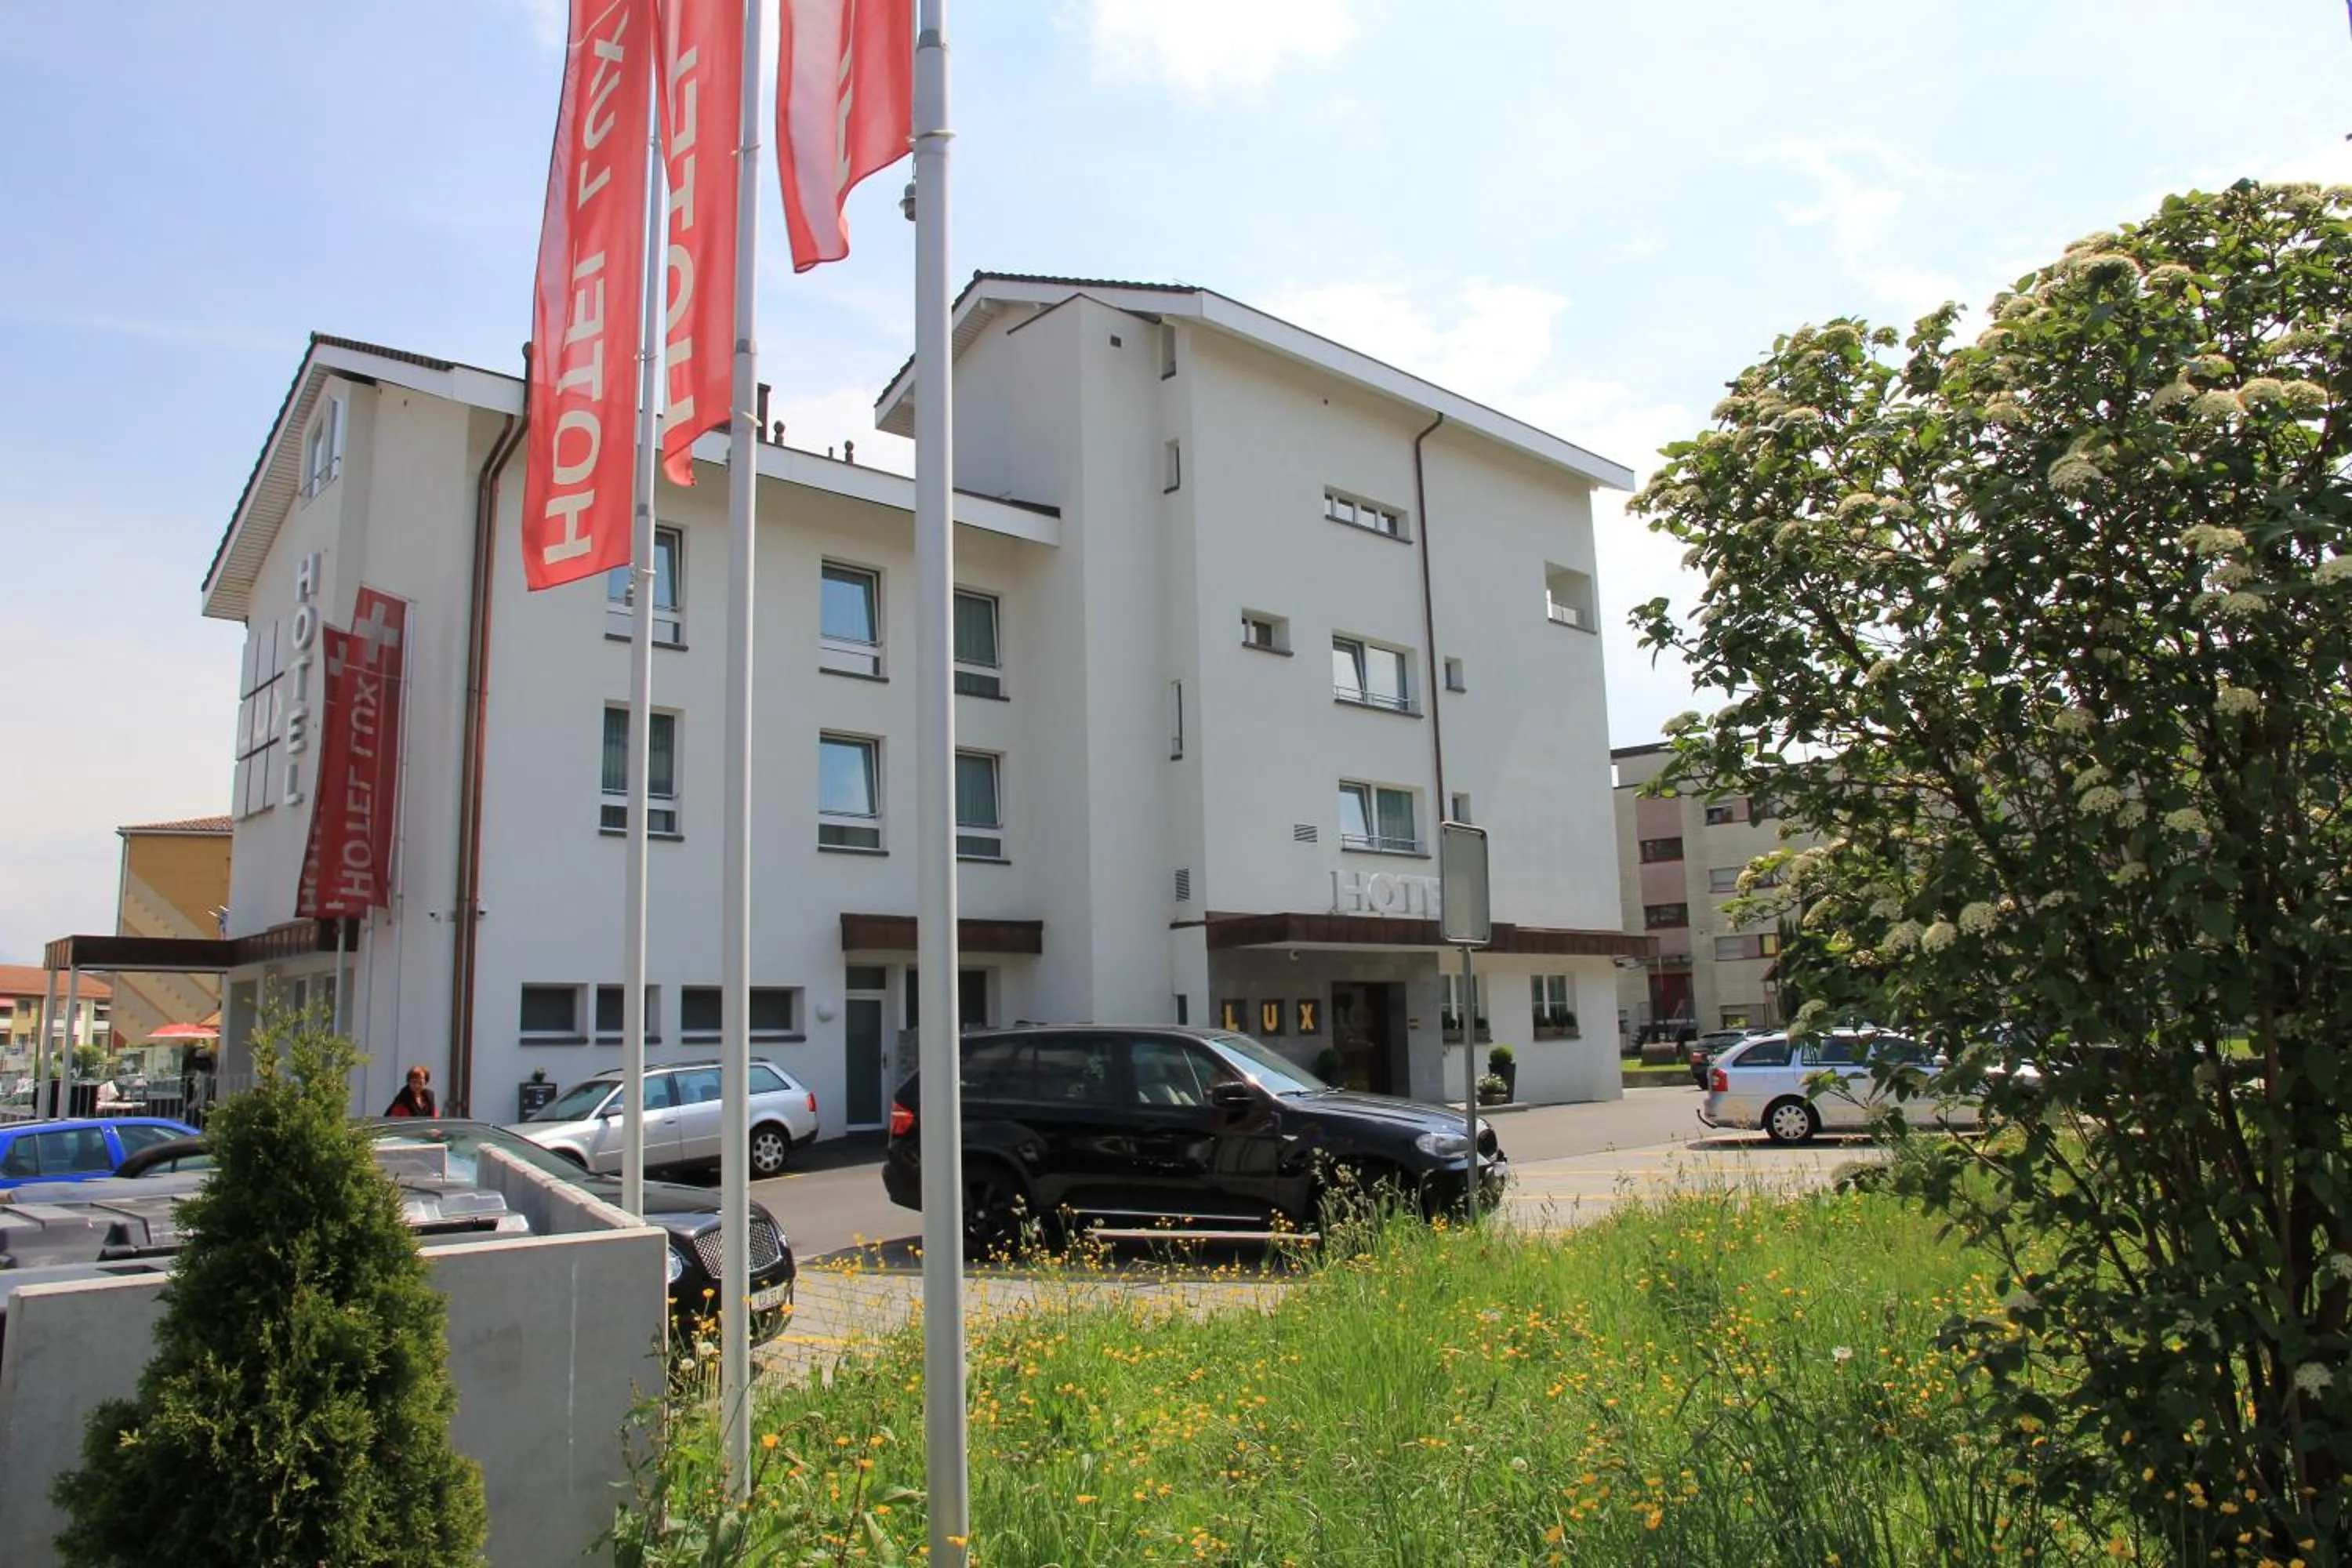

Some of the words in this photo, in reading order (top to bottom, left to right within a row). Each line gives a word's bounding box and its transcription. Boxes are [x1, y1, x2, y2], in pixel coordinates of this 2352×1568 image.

[284, 552, 321, 808] HOTEL
[1330, 870, 1440, 919] HOTE
[1225, 1004, 1315, 1032] LUX
